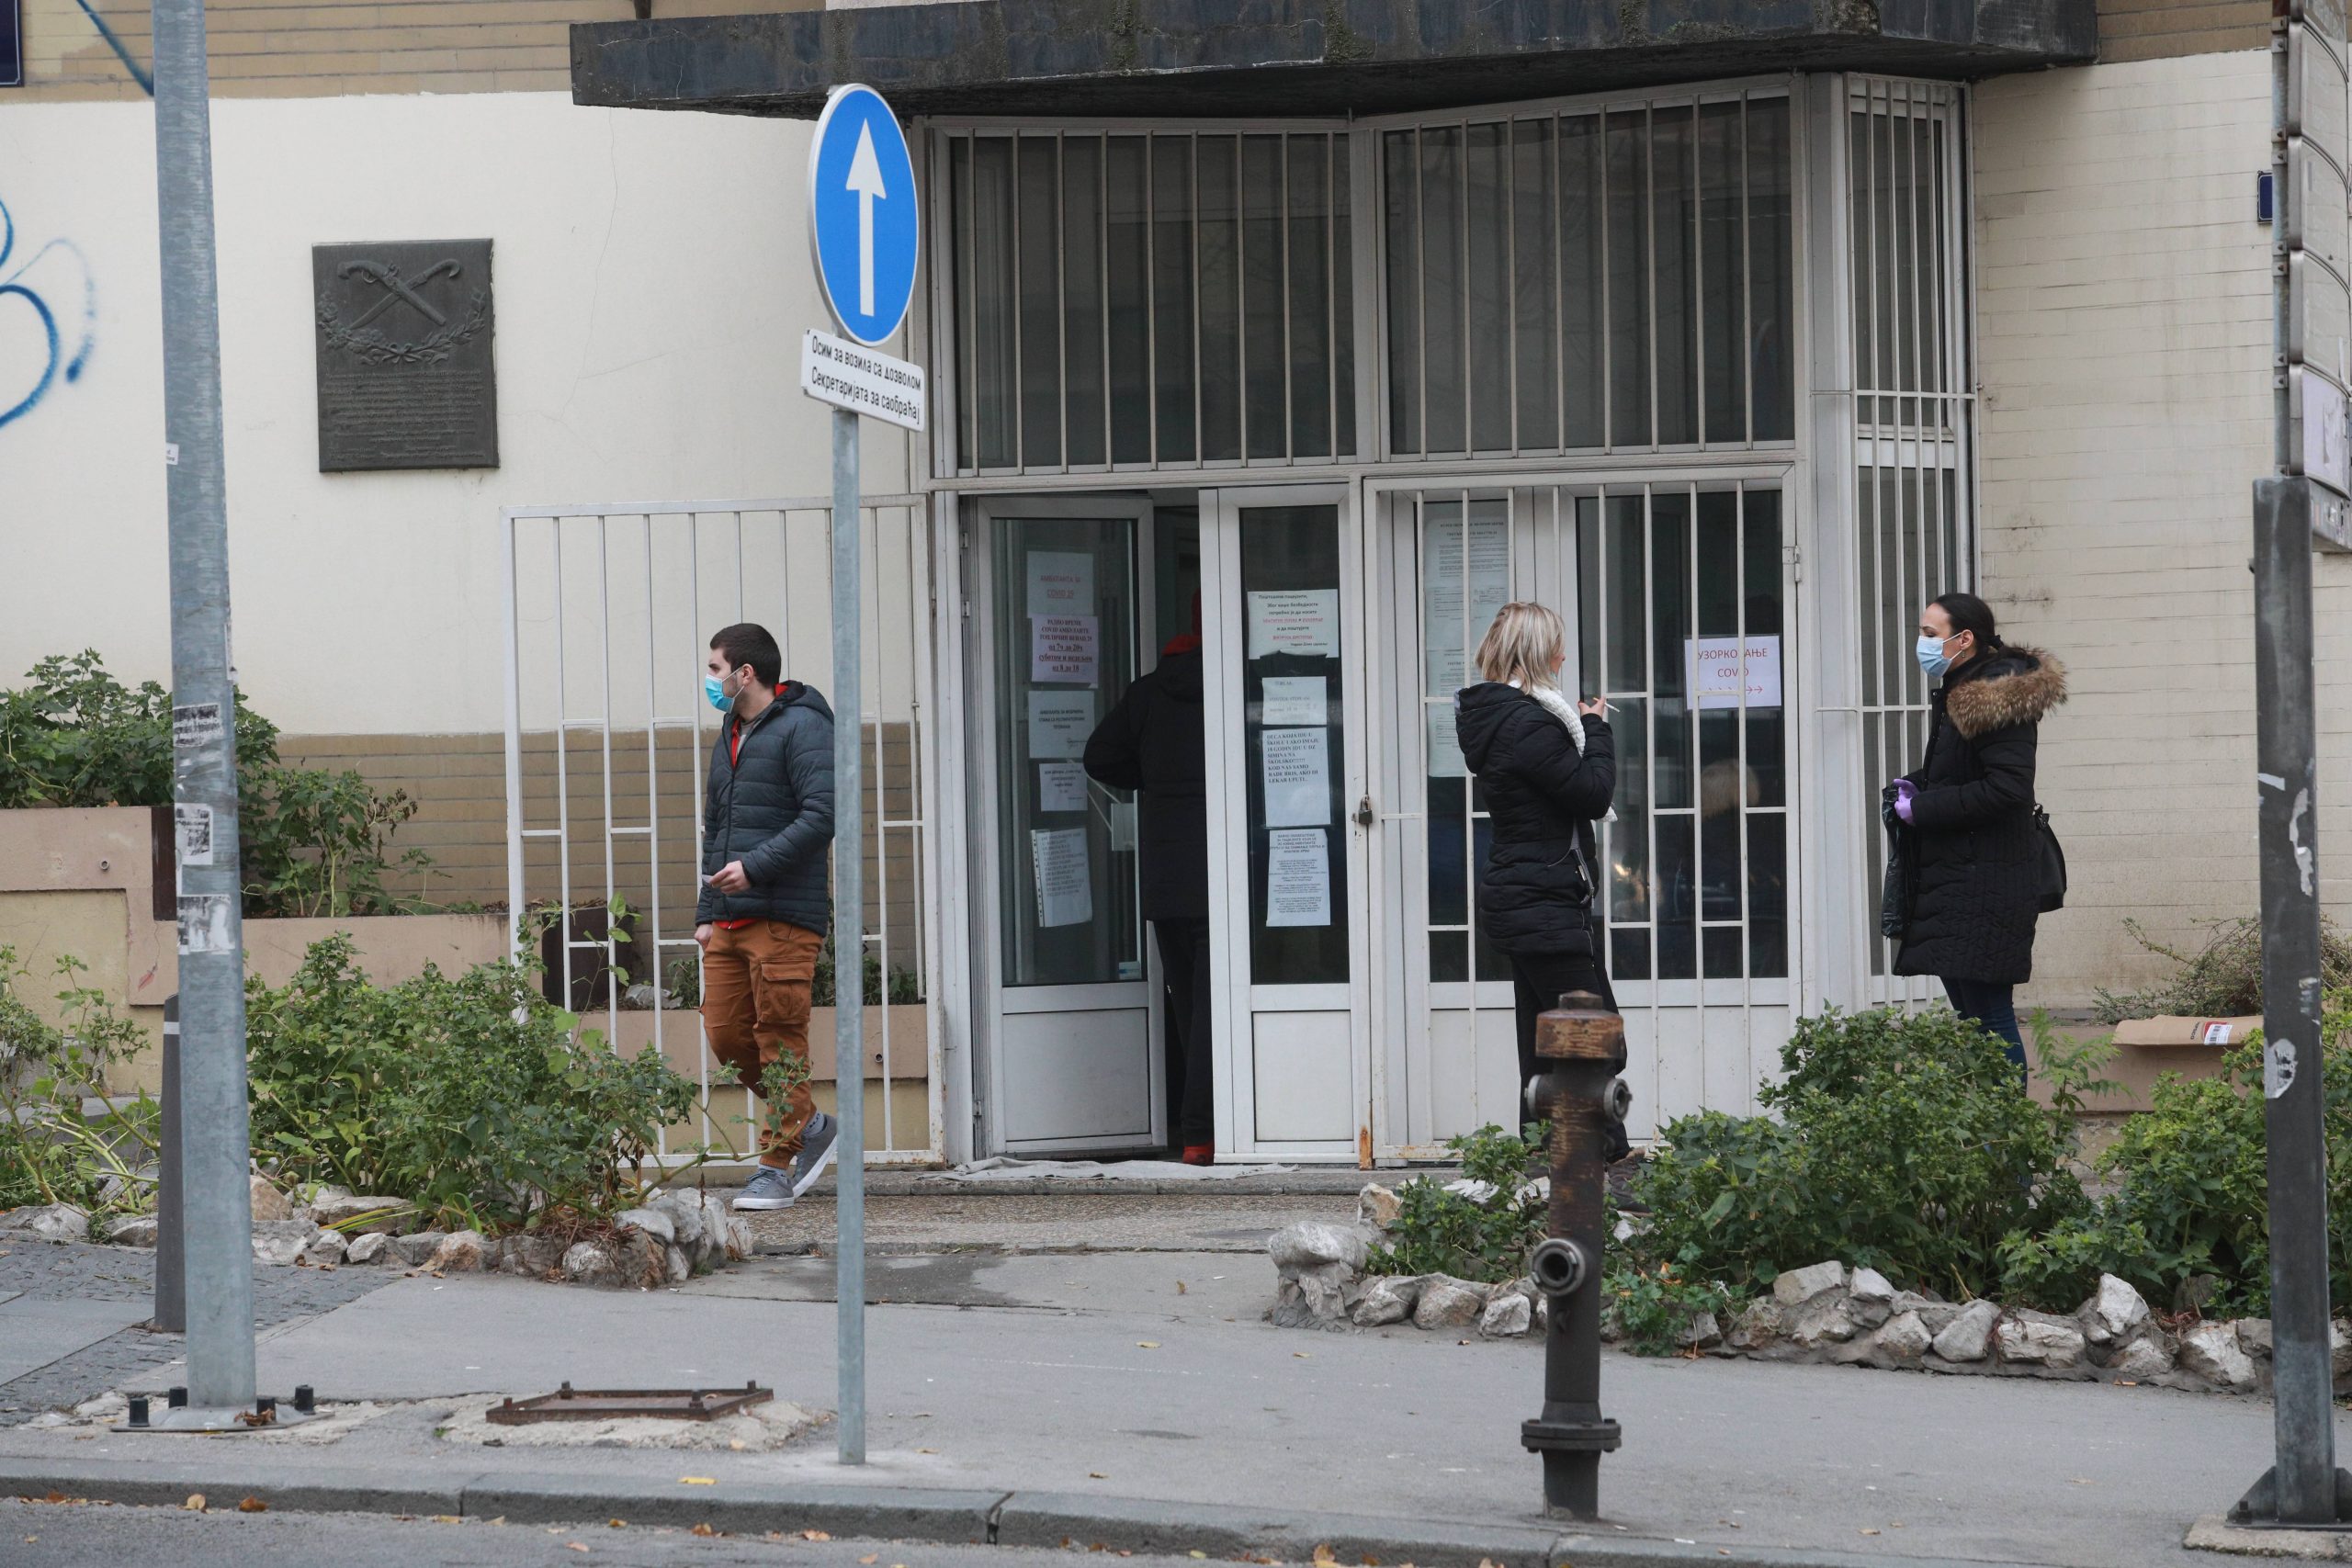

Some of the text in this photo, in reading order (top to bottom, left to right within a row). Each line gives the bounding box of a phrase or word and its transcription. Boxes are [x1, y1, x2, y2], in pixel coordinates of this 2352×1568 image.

[812, 335, 922, 391] Осим за возила са дозволом
[811, 367, 920, 424] Секретаријата за саобраћај
[1697, 648, 1769, 660] УЗОРКОАЊЕ
[1717, 668, 1749, 678] COVD
